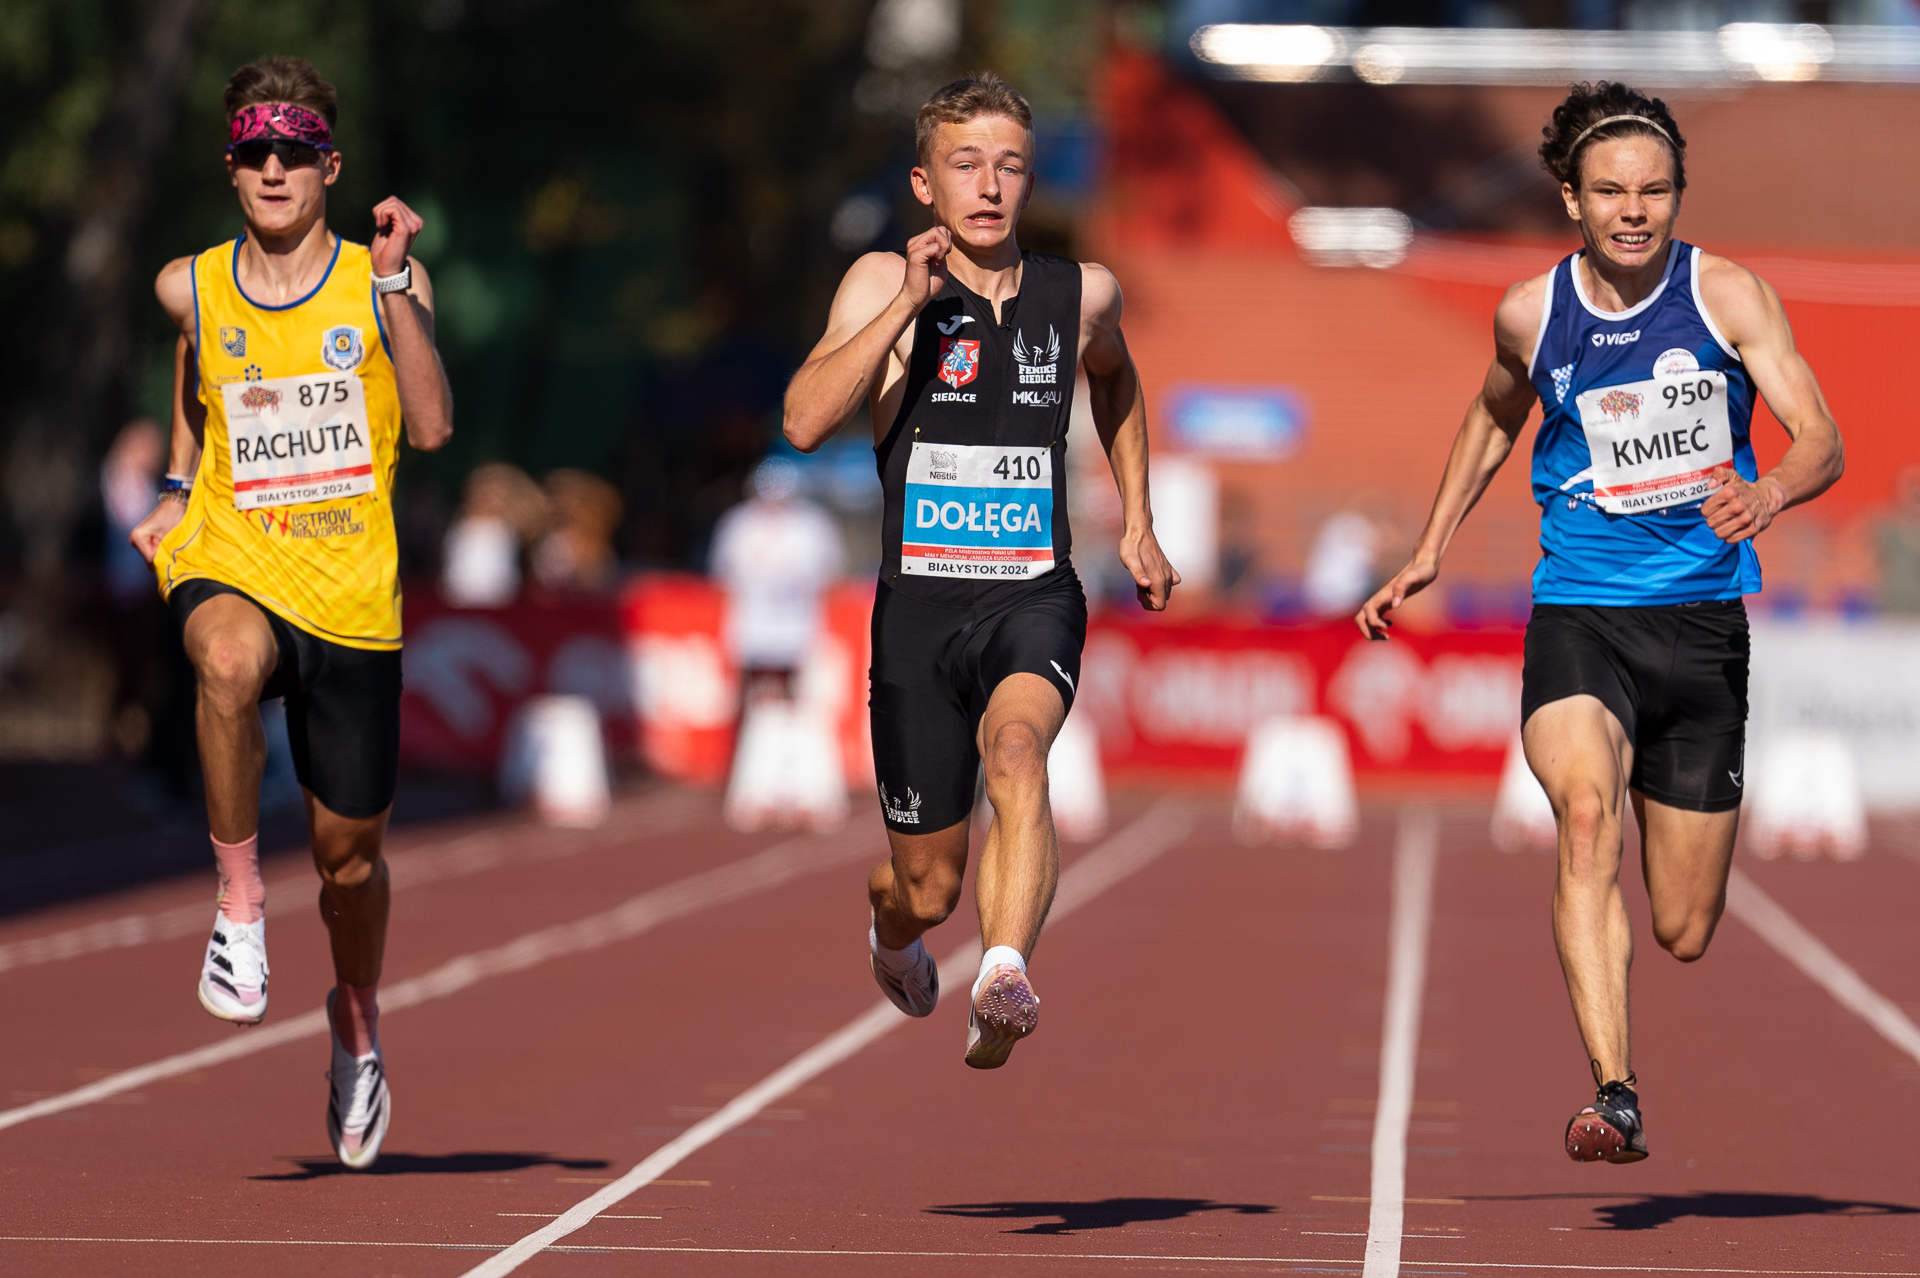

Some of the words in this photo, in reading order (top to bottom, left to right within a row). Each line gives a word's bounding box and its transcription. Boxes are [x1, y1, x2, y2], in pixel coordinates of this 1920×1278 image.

[1018, 363, 1057, 375] FENIKS
[1018, 373, 1057, 384] SIEDLCE
[298, 380, 349, 408] 875
[931, 392, 977, 403] SIEDLCE
[1662, 379, 1713, 409] 950
[236, 423, 363, 464] RACHUTA
[1612, 417, 1710, 468] KMIEĆ
[993, 455, 1041, 481] 410
[256, 487, 320, 503] BIAŁYSTOK
[322, 482, 352, 496] 2024
[1621, 490, 1688, 508] BIAŁYSTOK
[1690, 482, 1711, 496] 202
[291, 507, 352, 527] OSTRÓW
[915, 498, 1042, 538] DOŁĘGA
[291, 521, 365, 538] WIELKOPOLSKI
[928, 562, 998, 575] BIAŁYSTOK
[1000, 565, 1029, 575] 2024
